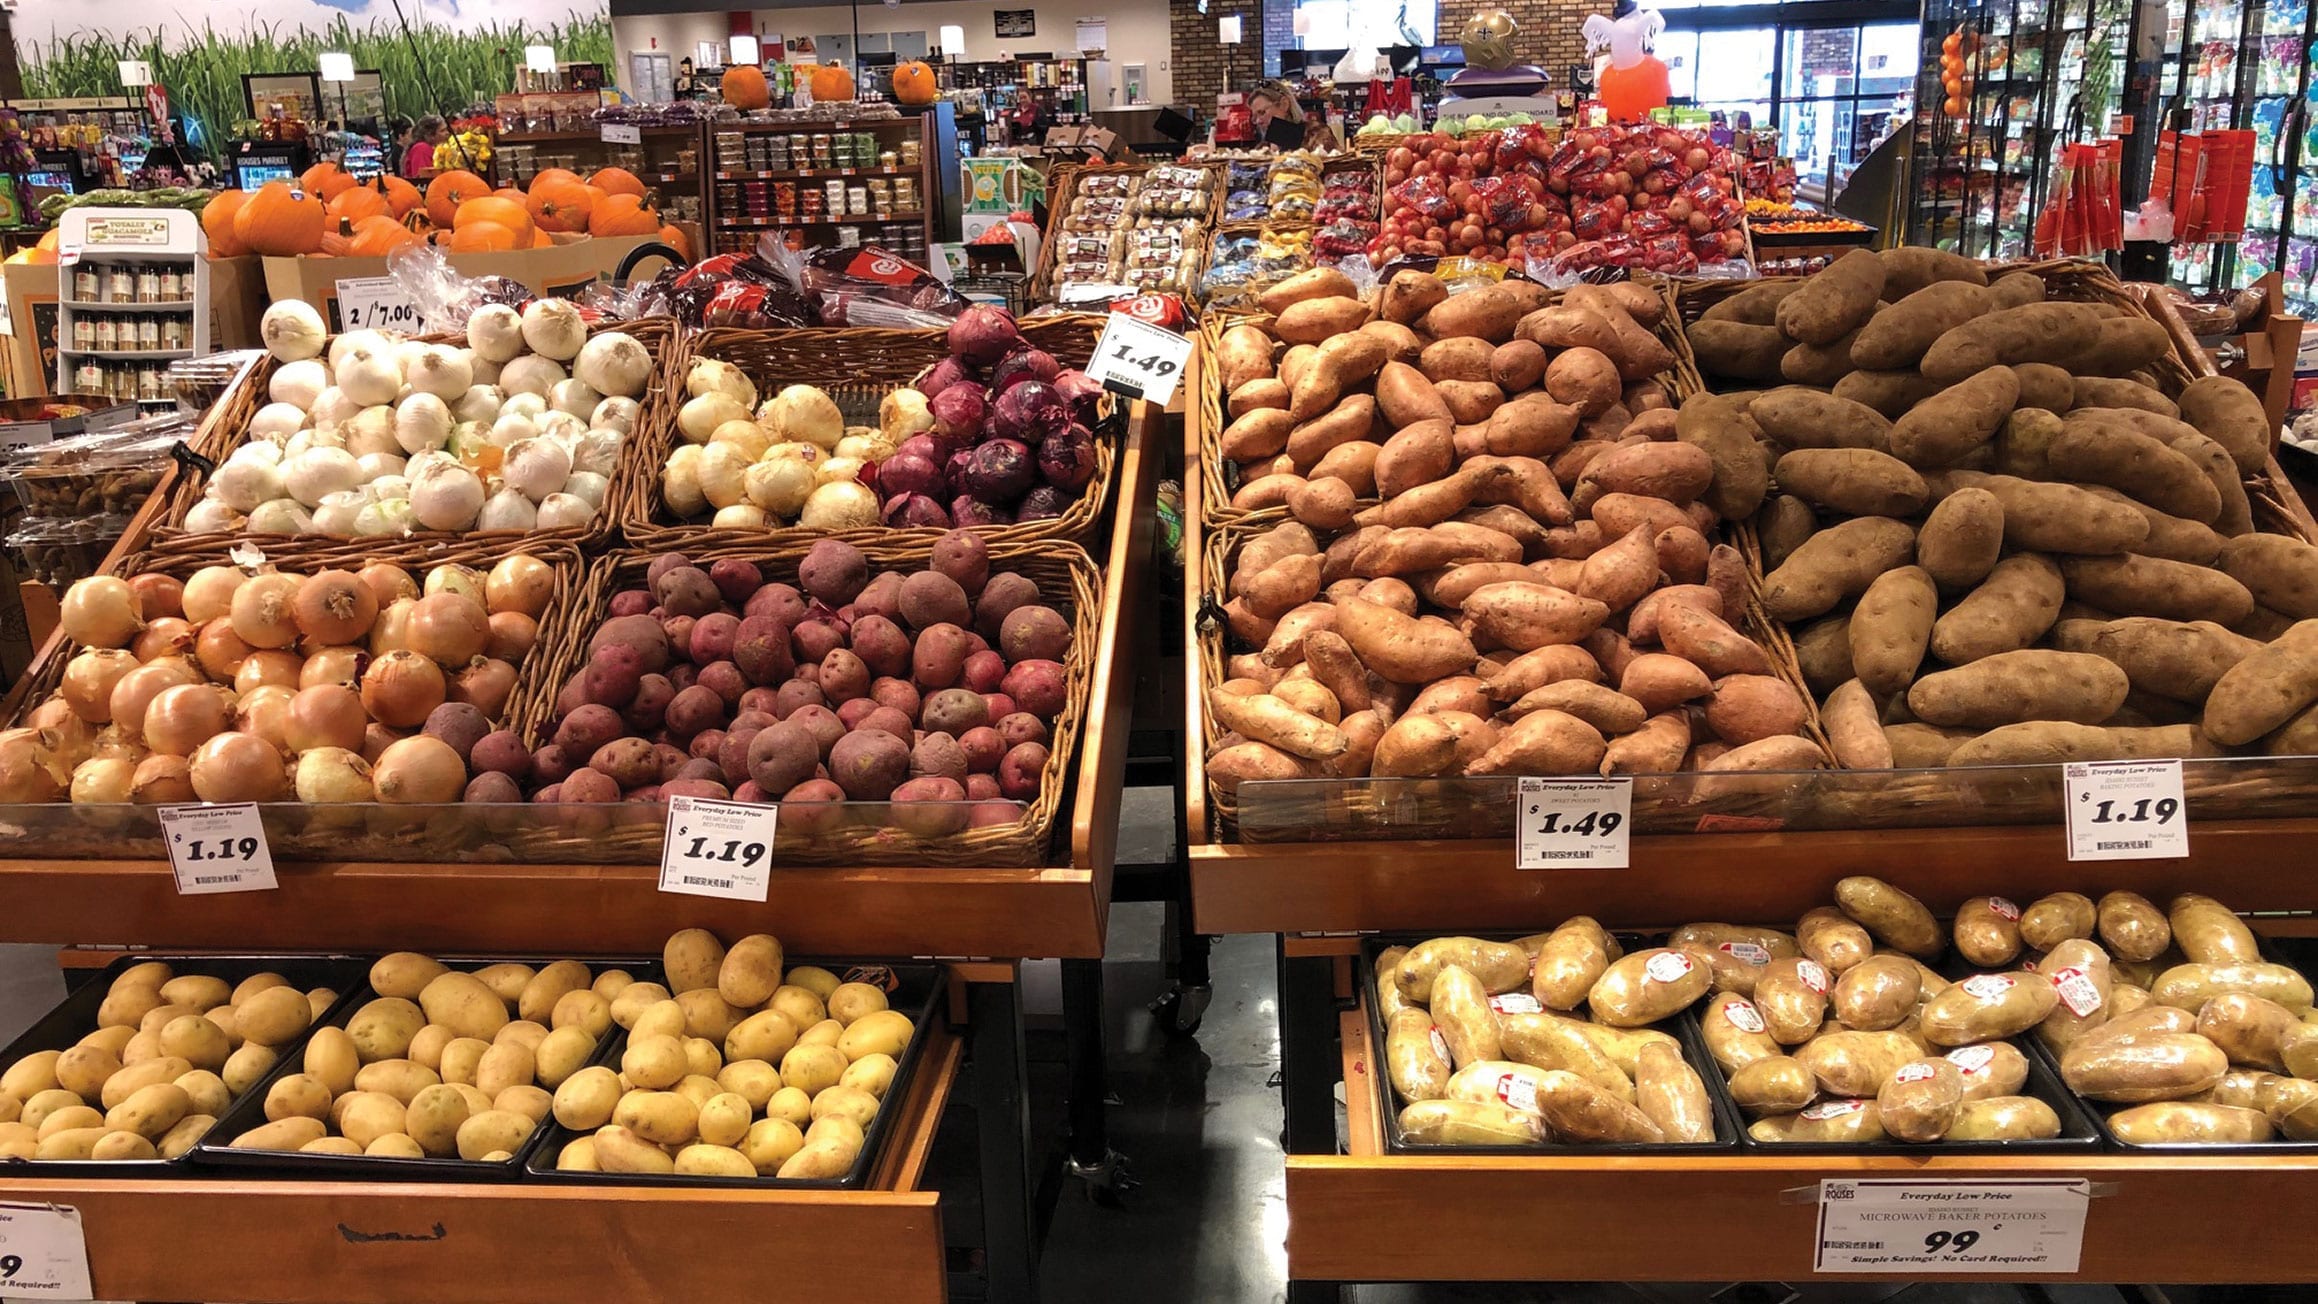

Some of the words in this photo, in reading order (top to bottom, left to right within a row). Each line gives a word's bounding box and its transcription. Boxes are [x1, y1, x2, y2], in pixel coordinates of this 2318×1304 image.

[1542, 784, 1577, 792] Everyday
[692, 805, 726, 815] Everyday
[1825, 1190, 1855, 1199] ROUSES
[1900, 1192, 1954, 1201] Everyday
[1955, 1192, 1981, 1200] Low
[1982, 1192, 2012, 1200] Price
[1860, 1213, 1936, 1221] MICROWAVE
[1938, 1213, 1981, 1221] BAKER
[1984, 1212, 2047, 1220] POTATOES
[1850, 1255, 1889, 1264] Simple
